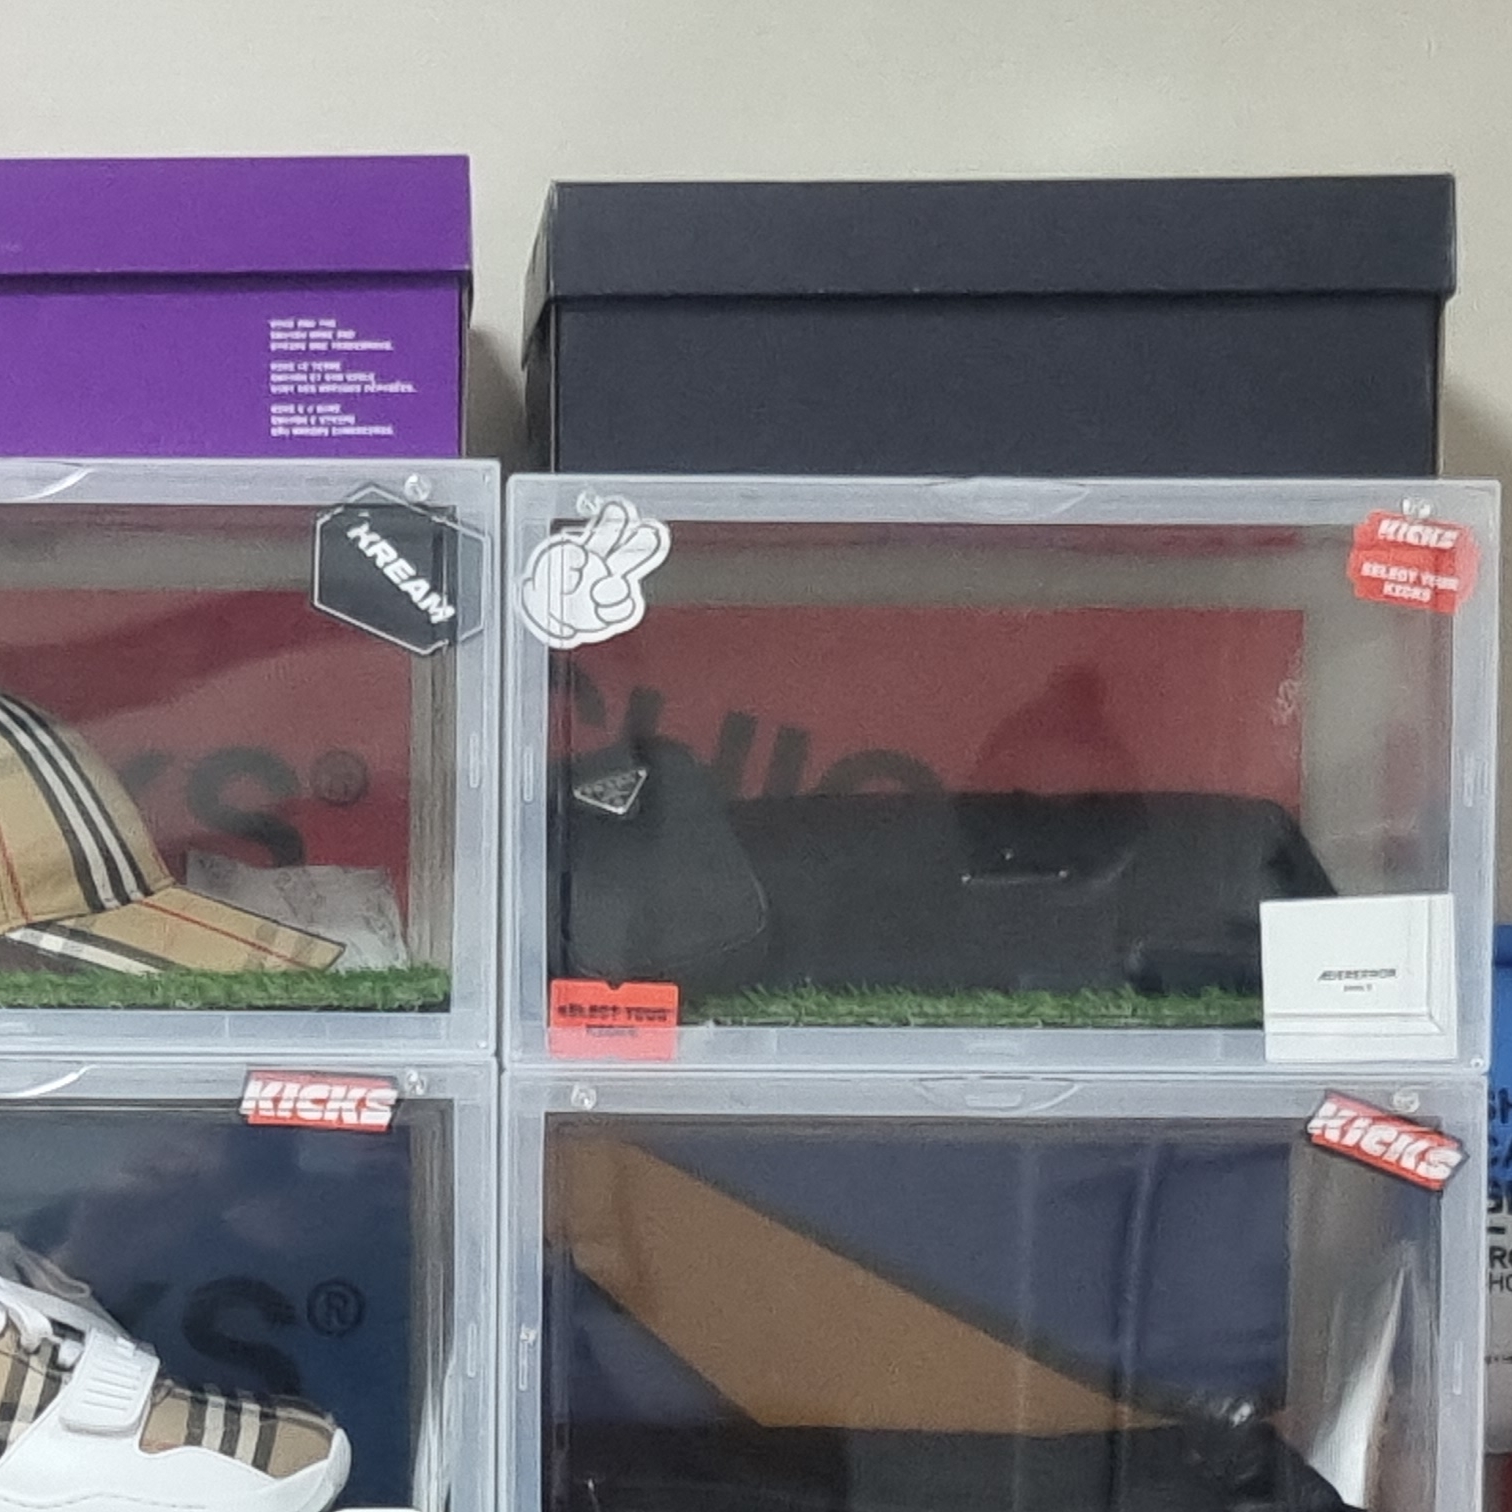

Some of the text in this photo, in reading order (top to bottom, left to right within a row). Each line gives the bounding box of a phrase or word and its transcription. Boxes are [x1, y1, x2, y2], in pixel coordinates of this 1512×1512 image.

[346, 522, 455, 624] KREAM
[238, 1079, 398, 1126] KICKS
[1307, 1101, 1463, 1181] KICKS
